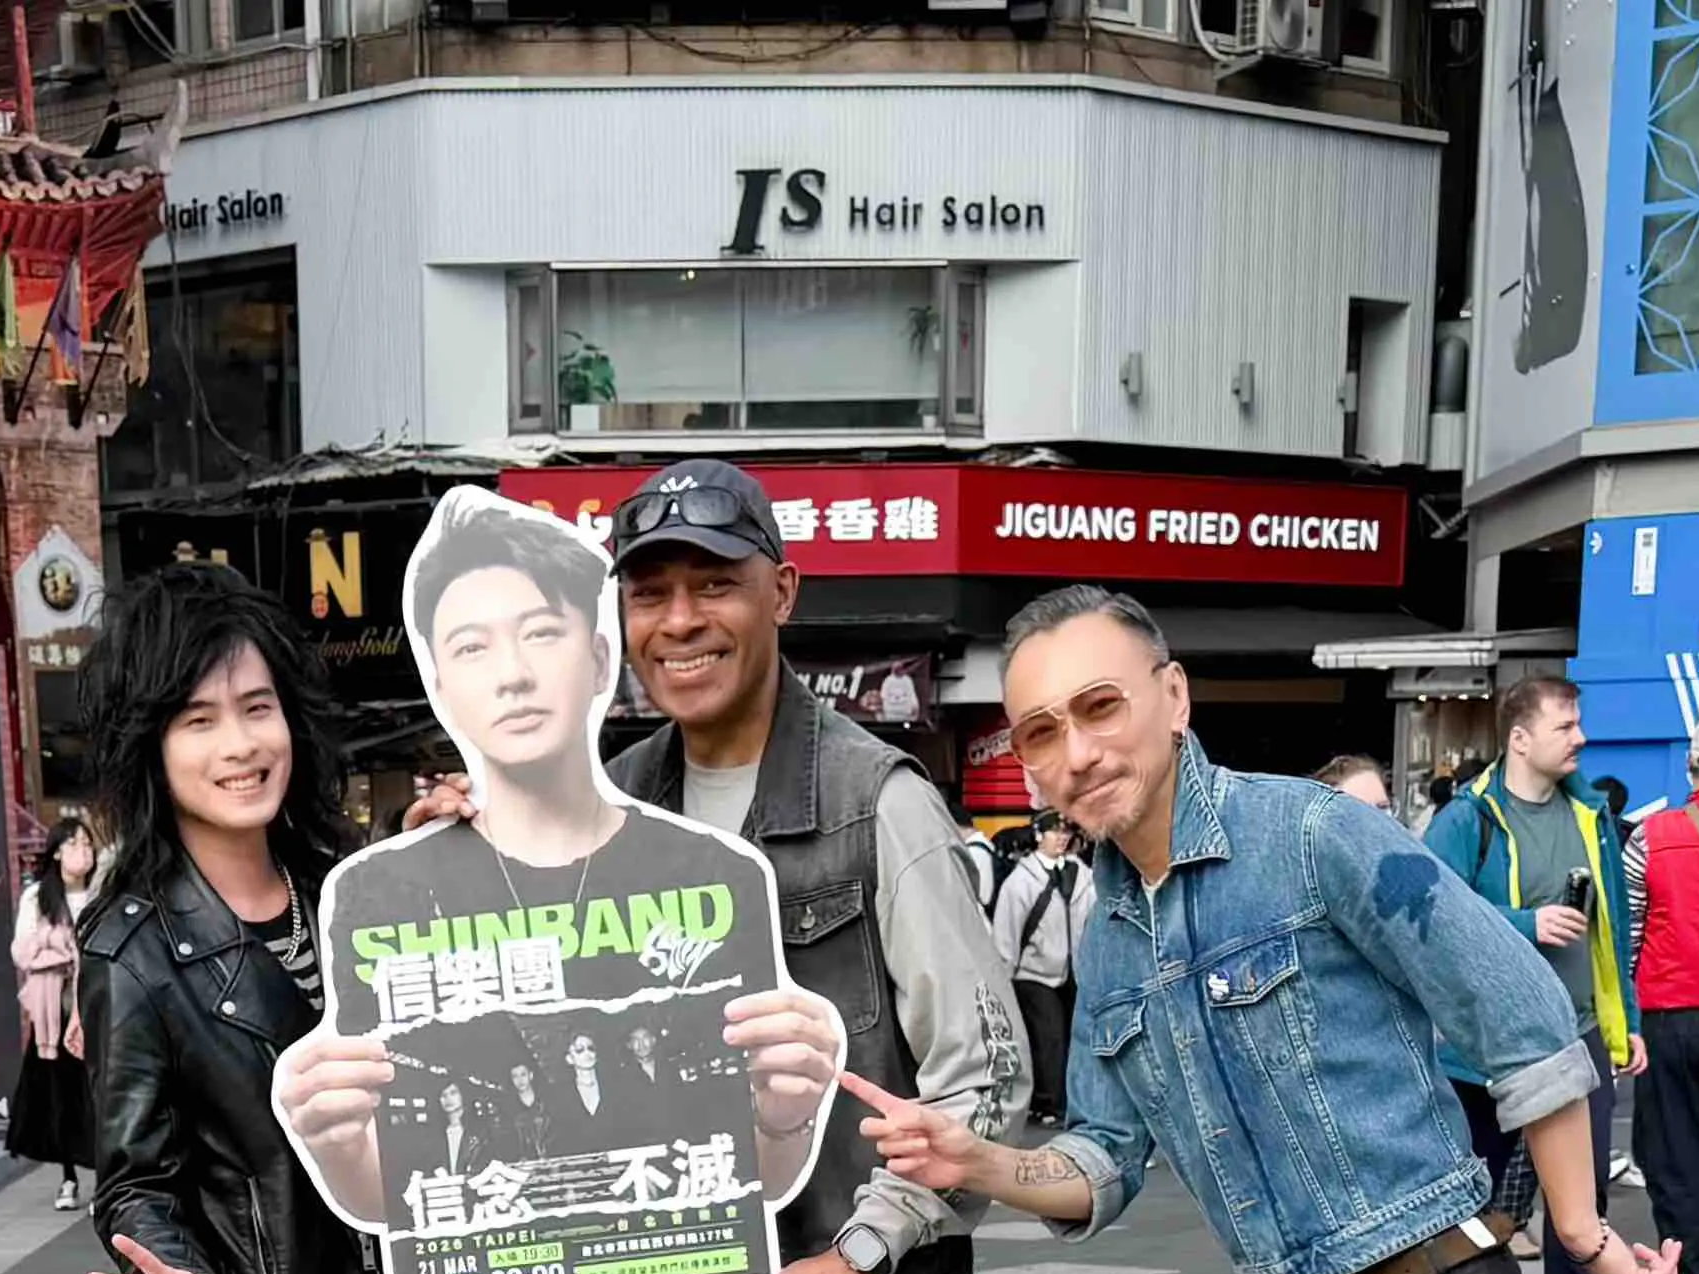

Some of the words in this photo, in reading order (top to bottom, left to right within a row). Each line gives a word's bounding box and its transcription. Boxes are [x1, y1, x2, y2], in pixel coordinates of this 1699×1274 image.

[217, 189, 283, 224] Salon
[720, 168, 826, 255] IS
[849, 196, 922, 230] Hair
[942, 195, 1044, 230] Salon
[771, 496, 939, 541] 香香雞
[995, 503, 1136, 542] JIGUANG
[1147, 509, 1241, 545] FRIED
[1249, 514, 1379, 551] CHICKEN
[815, 666, 864, 699] NO.1
[352, 884, 733, 985] SHINBAND
[369, 936, 566, 1024] 信樂團
[403, 1160, 537, 1229] 信念
[608, 1133, 738, 1201] 不滅
[415, 1239, 463, 1255] 2026
[472, 1229, 536, 1249] TAIPEI
